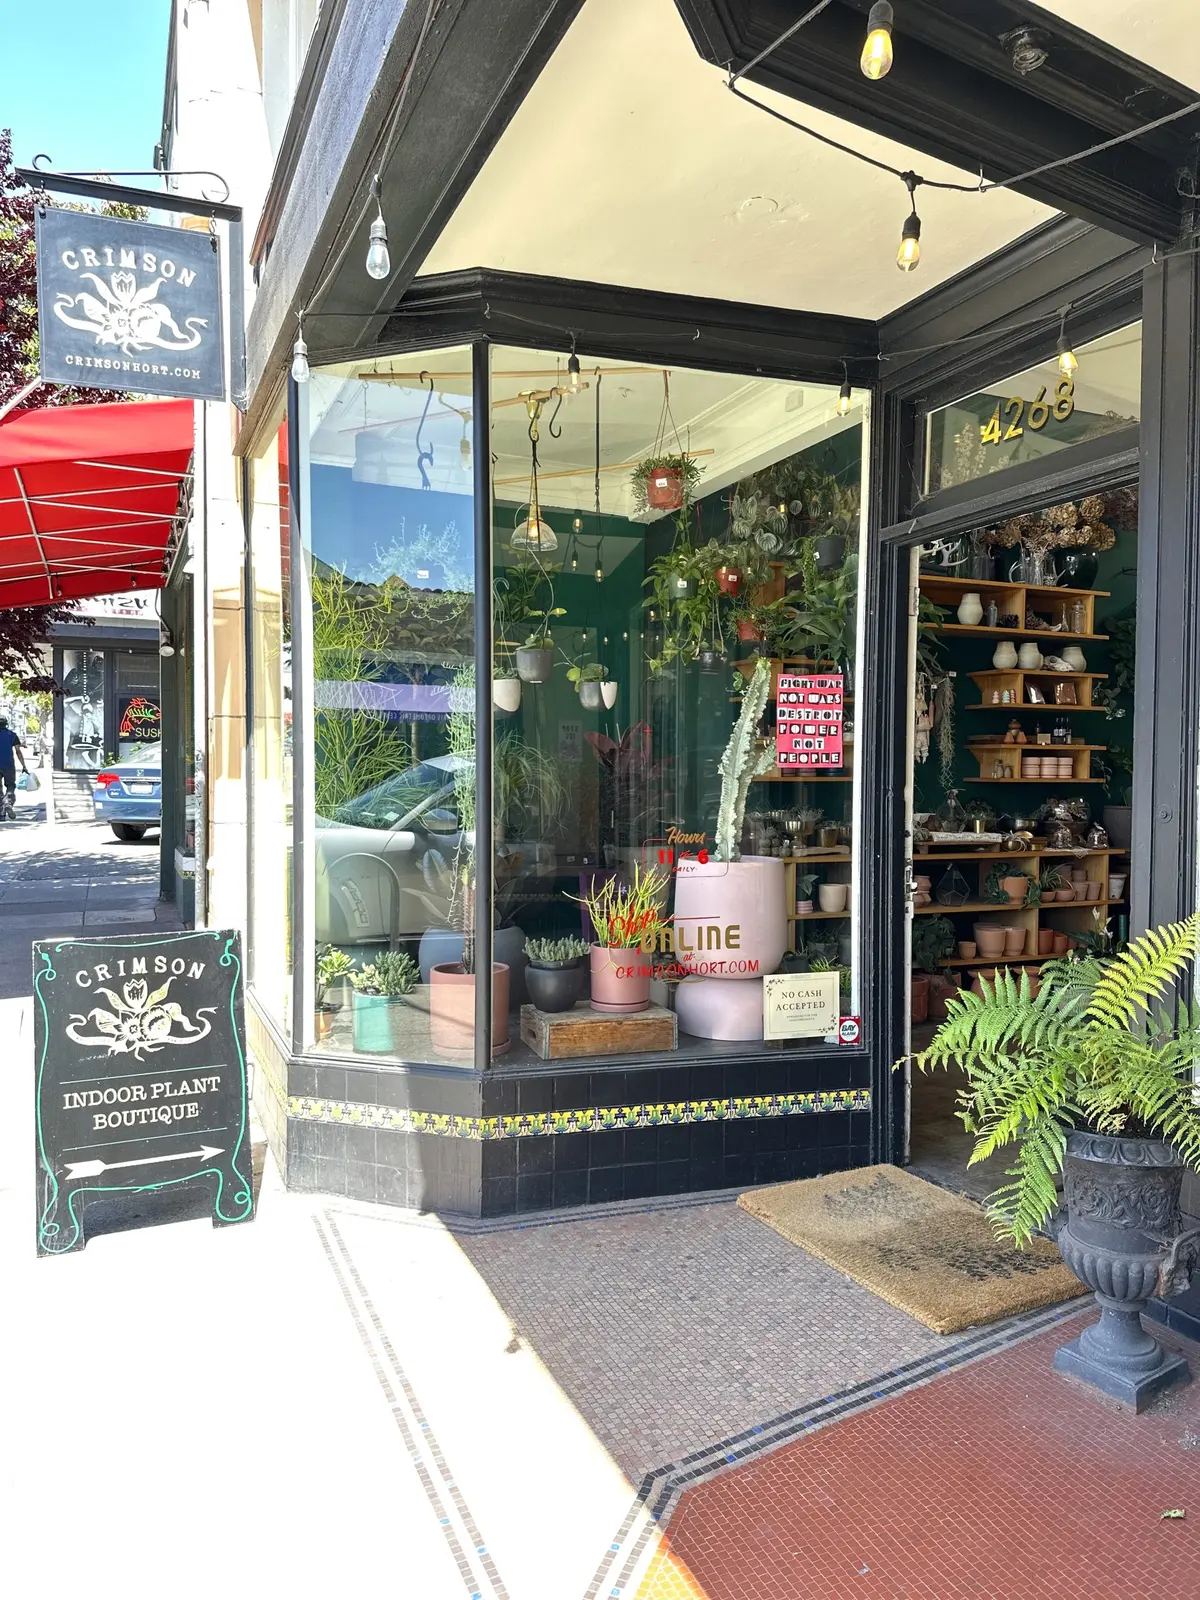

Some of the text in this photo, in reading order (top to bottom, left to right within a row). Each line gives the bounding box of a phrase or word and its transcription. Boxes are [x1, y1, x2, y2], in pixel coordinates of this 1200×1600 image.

[62, 248, 197, 287] CRIMSON
[65, 354, 201, 379] CRIMSONHORT.COM
[981, 374, 1075, 446] 4268
[780, 678, 842, 689] FIGHT WAR
[779, 693, 841, 704] NOT WARS
[778, 709, 842, 720] DESTROY
[779, 724, 838, 735] POWER
[793, 740, 823, 749] NOT
[779, 753, 840, 763] PEOPLE
[665, 826, 706, 845] Hours
[658, 849, 674, 864] 11
[697, 848, 709, 864] 6
[640, 925, 741, 953] ONLINE
[75, 954, 206, 987] CRIMSON
[616, 959, 759, 979] CRIMSONHORT.COM
[781, 989, 822, 999] NO CASH
[776, 1001, 826, 1011] ACCEPTED
[62, 1076, 221, 1110] INDOOR PLANT
[92, 1102, 200, 1132] BOUTIQUE
